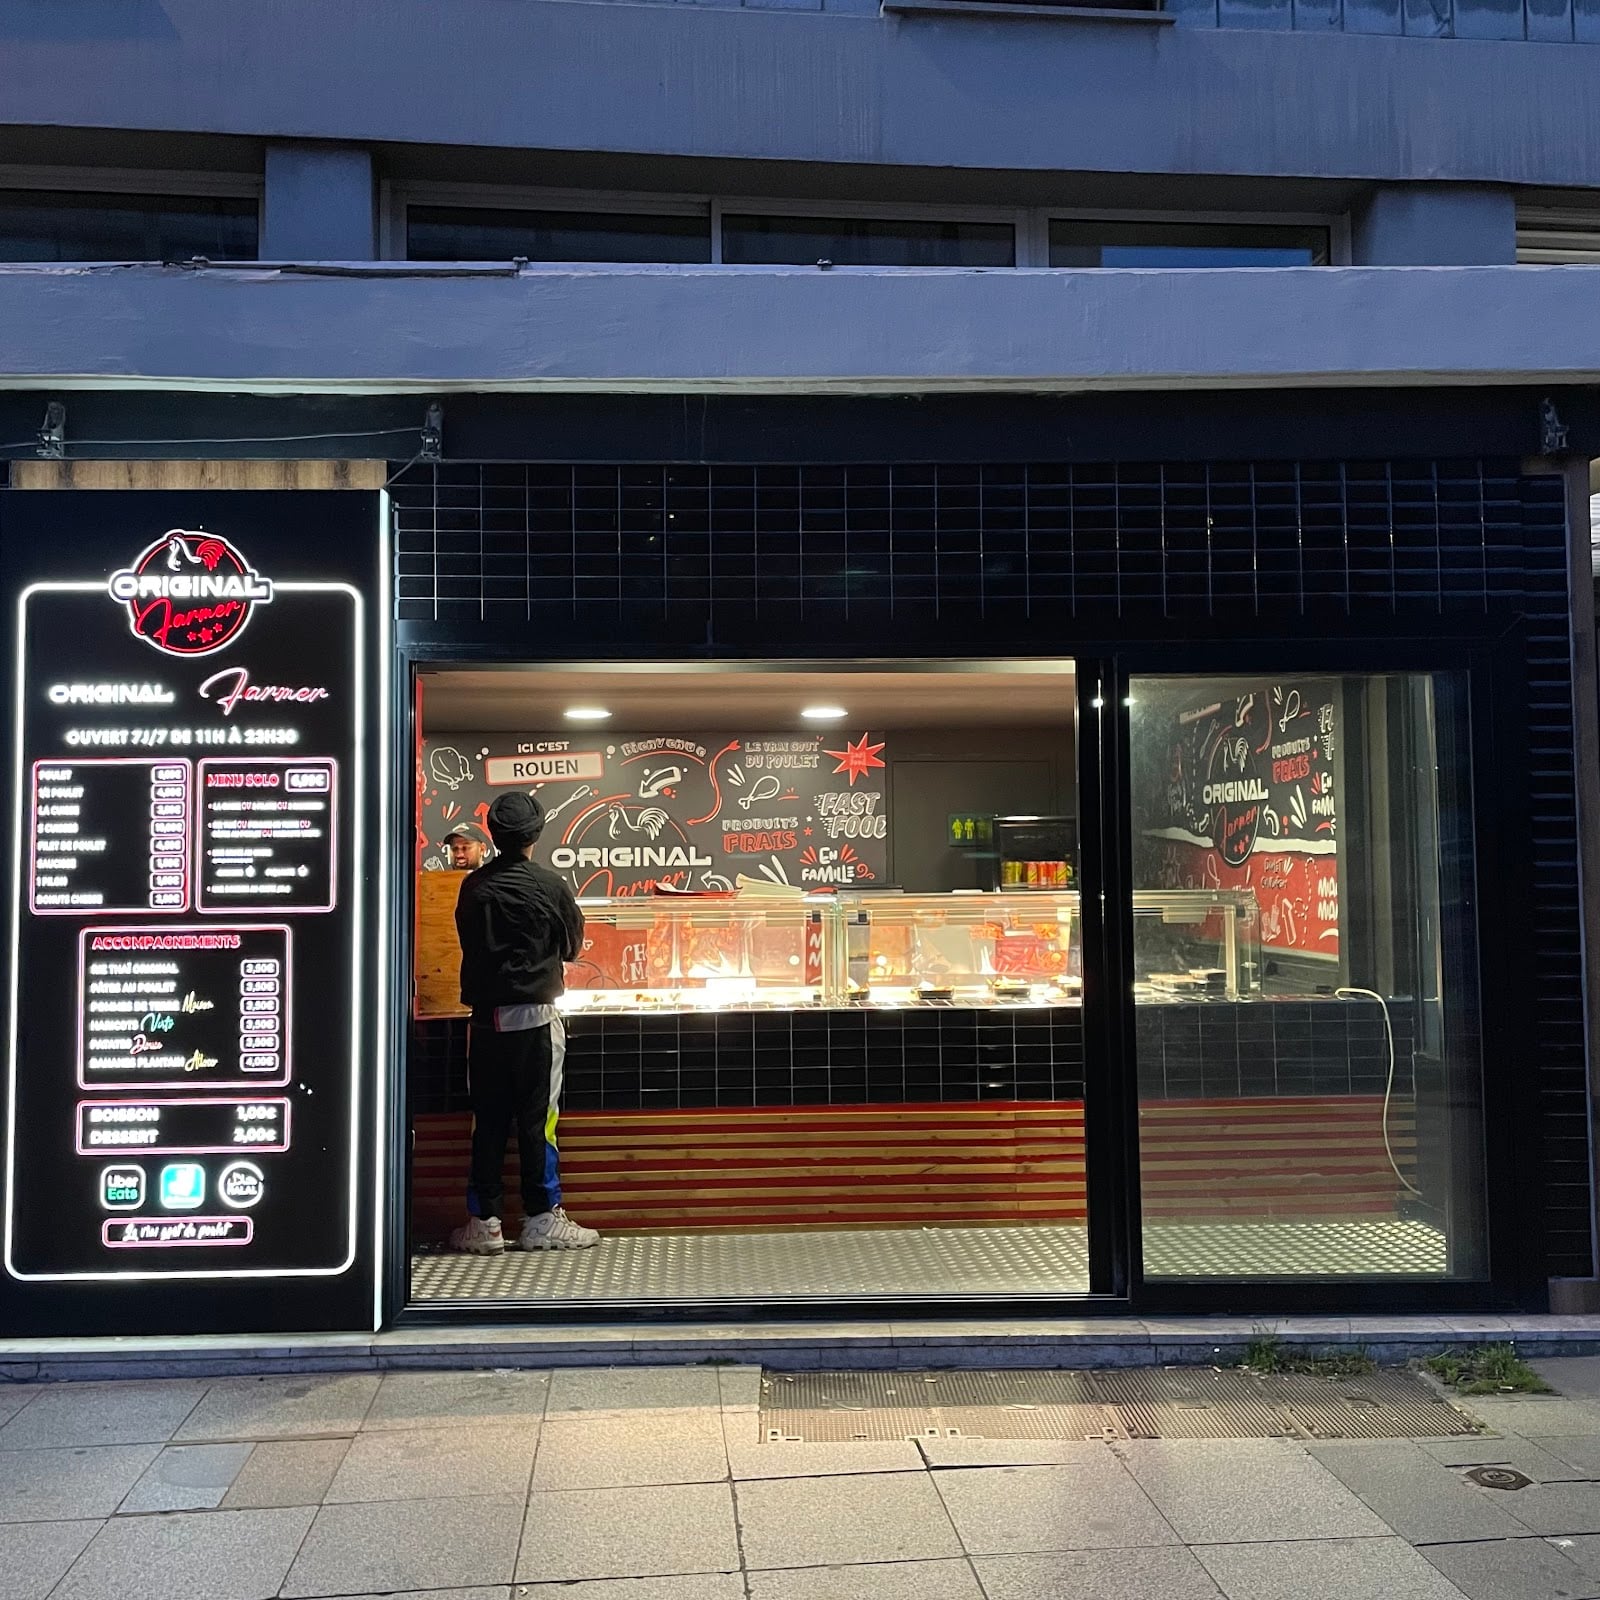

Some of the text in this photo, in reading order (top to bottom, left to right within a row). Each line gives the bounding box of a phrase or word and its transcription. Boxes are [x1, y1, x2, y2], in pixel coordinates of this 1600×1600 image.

[114, 576, 268, 598] ORIGINAL
[135, 599, 242, 647] Farmer
[49, 667, 329, 716] ORIGINAL Farmer
[66, 730, 128, 745] OUVERT
[131, 729, 166, 747] 7J/7
[171, 730, 192, 744] DE
[195, 730, 225, 744] 11H
[228, 727, 242, 744] À
[517, 741, 570, 753] ICI C'EST
[745, 741, 762, 752] LE
[763, 741, 789, 752] VRAI
[512, 759, 580, 778] ROUEN
[745, 753, 821, 769] DU POULET
[208, 774, 244, 786] MENU
[245, 773, 280, 787] SOLO
[1202, 777, 1269, 804] ORIGINAL
[820, 791, 882, 815] FAST
[721, 817, 800, 831] PRODUITS
[831, 814, 888, 839] FOOD
[722, 831, 798, 853] FRAIS
[551, 845, 712, 869] ORIGINAL
[801, 863, 856, 884] FAMILLE
[92, 934, 241, 949] ACCOMPAGNEMENTS
[90, 1107, 160, 1123] BOISSON
[90, 1129, 160, 1144] DESSERT
[108, 1173, 139, 1188] Uber
[107, 1188, 138, 1200] Eats
[227, 1185, 258, 1196] HALAL
